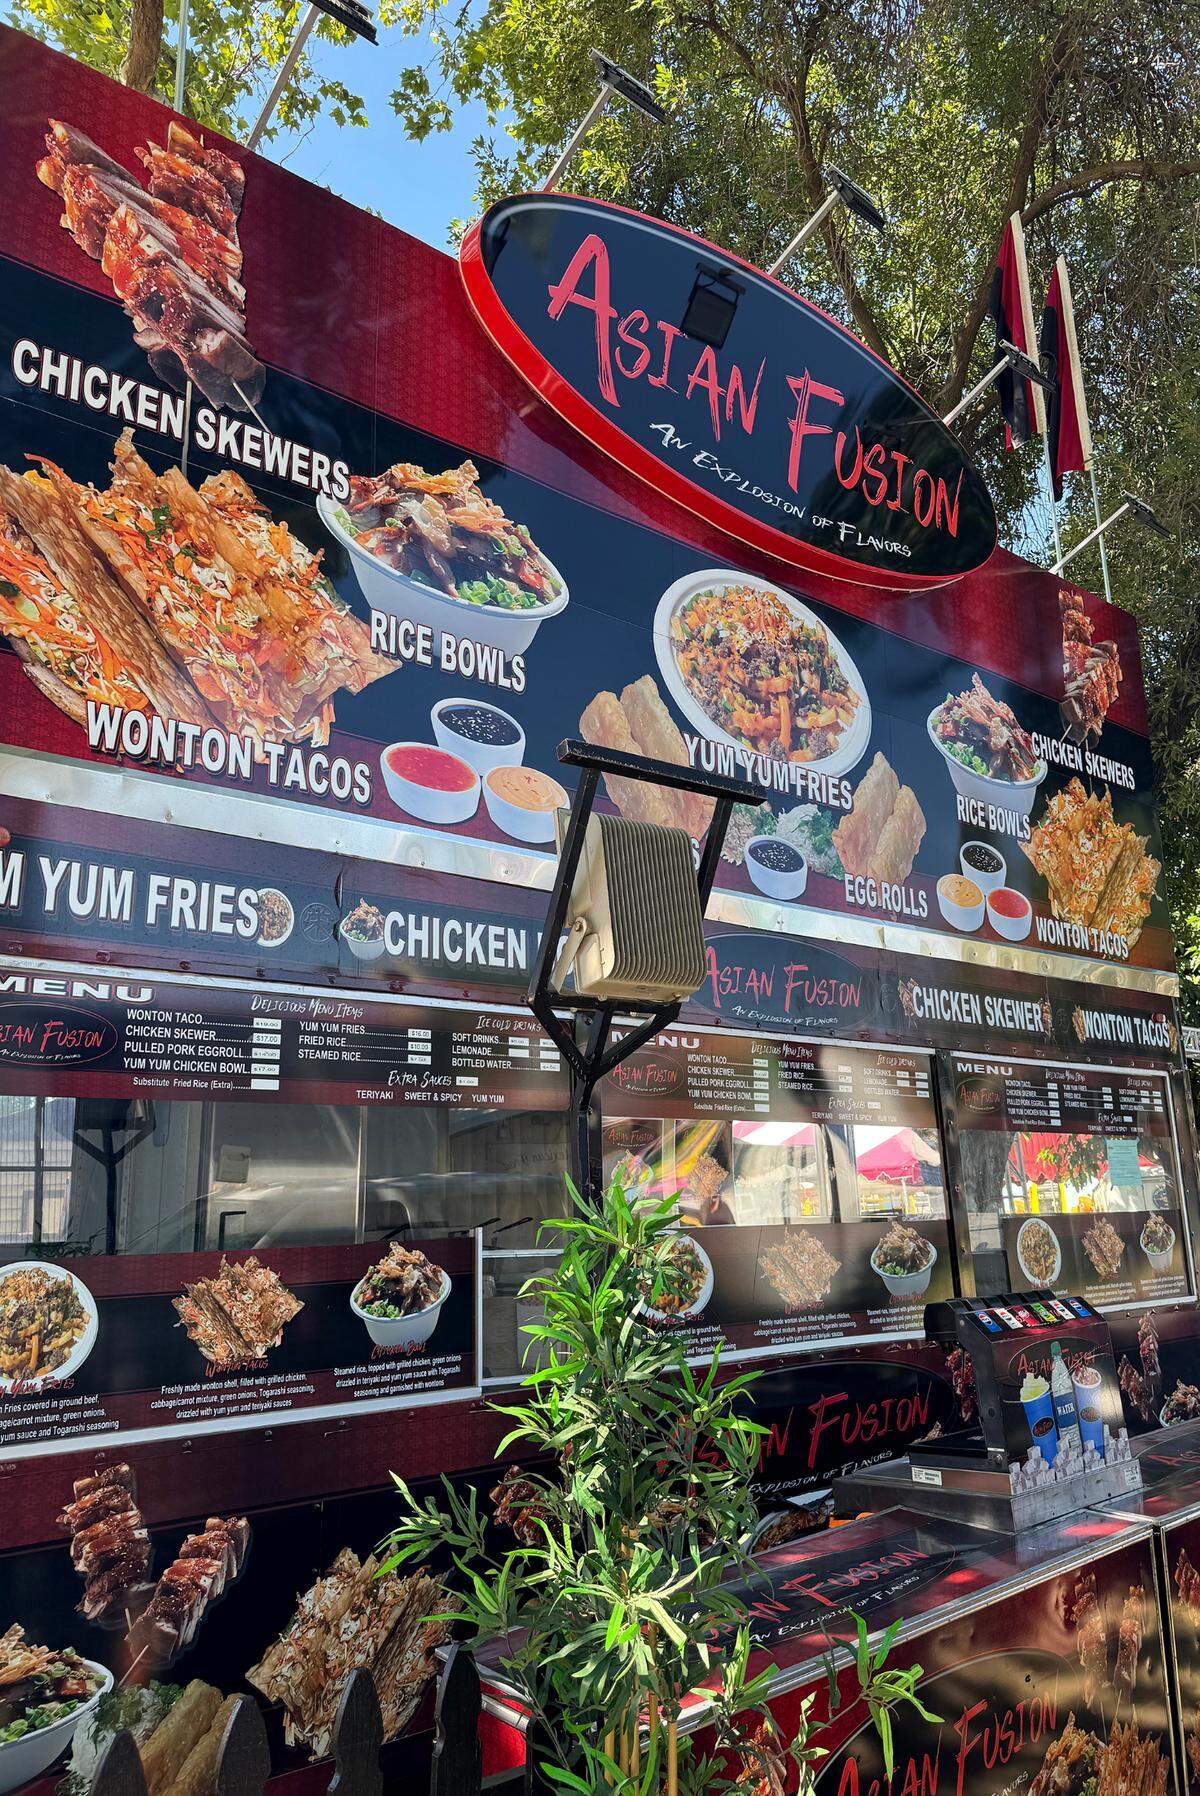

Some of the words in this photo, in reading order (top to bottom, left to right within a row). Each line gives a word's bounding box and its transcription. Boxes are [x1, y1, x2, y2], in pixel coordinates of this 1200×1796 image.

[548, 233, 766, 441] ASIAN
[786, 367, 964, 538] FUSION
[14, 339, 185, 439] CHICKEN
[195, 408, 350, 501] SKEWERS
[649, 422, 693, 449] AN
[693, 451, 805, 519] EXPLOSION
[812, 514, 832, 528] OF
[835, 521, 912, 557] FLAVORS
[371, 609, 433, 666] RICE
[441, 632, 527, 693] BOWLS
[87, 700, 253, 782] WONTON
[264, 741, 372, 804] TACOS
[1031, 732, 1082, 774] CHICKEN
[1083, 748, 1136, 791] SKEWERS
[683, 734, 735, 778] YUM
[741, 750, 791, 793] YUM
[795, 767, 853, 812] FRIES
[956, 794, 984, 826] RICE
[987, 802, 1031, 841] BOWLS
[39, 856, 135, 923] YUM
[146, 873, 259, 938] FRIES
[844, 875, 878, 908] EGG
[881, 882, 928, 917] ROLLS
[384, 911, 527, 969] CHICKEN
[1036, 916, 1088, 951] WONTON
[1090, 927, 1129, 959] TACOS
[0, 976, 153, 1002] MENU
[705, 945, 776, 1008] ASIAN
[783, 961, 863, 1013] FUSION
[127, 1009, 172, 1023] WONTON
[175, 1011, 202, 1024] TACO
[251, 995, 306, 1013] DELICIOUS
[308, 998, 334, 1018] MENU
[731, 1005, 746, 1016] AN
[747, 1010, 793, 1023] EXPLOSION
[912, 985, 982, 1025] CHICKEN
[985, 995, 1043, 1032] SKEWER
[126, 1025, 171, 1039] CHICKEN
[173, 1028, 216, 1041] SKEWER
[256, 1035, 278, 1043] $17.00
[300, 1021, 319, 1031] YUM
[321, 1022, 339, 1032] YUM
[341, 1024, 365, 1034] FRIES
[475, 1015, 491, 1029] ICE
[492, 1017, 511, 1031] COLD
[513, 1018, 542, 1032] DRINKS
[1082, 1009, 1133, 1042] WONTON
[1134, 1016, 1170, 1048] TACOS
[40, 1020, 106, 1052] FUSION
[299, 1035, 322, 1045] FRIED
[324, 1037, 346, 1047] RICE
[452, 1033, 472, 1043] SOFT
[473, 1034, 500, 1044] DRINKS
[124, 1041, 165, 1054] PULLED
[167, 1043, 195, 1056] PORK
[197, 1045, 244, 1058] EGGROLL
[298, 1050, 339, 1061] STEAMED
[341, 1051, 361, 1062] RICE
[452, 1045, 492, 1056] LEMONADE
[687, 1053, 710, 1064] WONTON
[123, 1057, 147, 1070] YUM
[149, 1059, 171, 1072] YUM
[173, 1060, 217, 1073] CHICKEN
[220, 1062, 249, 1075] BOWL
[452, 1058, 486, 1068] BOTTLED
[487, 1060, 511, 1069] WATER
[687, 1065, 712, 1075] CHICKEN
[957, 1062, 1013, 1075] MENU
[133, 1075, 169, 1088] Substitute
[173, 1078, 192, 1088] Fried
[194, 1079, 209, 1089] Rice
[210, 1079, 234, 1091] (Extra)
[388, 1070, 417, 1087] EXTRA
[420, 1071, 452, 1088] SAUCES
[688, 1078, 709, 1087] PULLED
[710, 1079, 724, 1088] PORK
[778, 1082, 801, 1090] STEAMED
[356, 1090, 393, 1100] TERIYAKI
[405, 1091, 432, 1101] SWEET
[433, 1092, 440, 1101] &
[441, 1093, 462, 1103] SPICY
[472, 1094, 487, 1103] YUM
[489, 1095, 505, 1103] YUM
[687, 1089, 701, 1098] YUM
[701, 1090, 713, 1099] YUM
[713, 1091, 737, 1100] CHICKEN
[334, 1366, 355, 1376] Steamed
[368, 1362, 385, 1373] topped
[386, 1361, 397, 1370] with
[397, 1359, 411, 1371] grilled
[446, 1354, 462, 1363] onions
[161, 1384, 184, 1396] Freshly
[185, 1382, 200, 1391] made
[201, 1381, 223, 1391] wonton
[240, 1377, 254, 1387] filled
[255, 1376, 267, 1385] with
[267, 1374, 284, 1386] grilled
[285, 1372, 307, 1382] chicken,
[336, 1377, 356, 1388] drizzled
[362, 1374, 380, 1386] teriyaki
[413, 1370, 427, 1378] sauce
[428, 1368, 438, 1376] with
[439, 1365, 460, 1377] Togarashi
[151, 1396, 195, 1409] cabbage/carrot
[196, 1394, 219, 1404] mixture,
[220, 1393, 237, 1404] green
[259, 1386, 286, 1399] Togarashi
[354, 1387, 379, 1398] seasoning
[380, 1385, 389, 1394] and
[390, 1382, 413, 1394] garnished
[414, 1381, 424, 1390] with
[425, 1379, 445, 1389] wontons
[4, 1403, 21, 1413] Fries
[23, 1400, 50, 1411] covered
[51, 1399, 58, 1408] in
[59, 1396, 83, 1409] ground
[84, 1394, 100, 1405] beef,
[176, 1408, 199, 1419] drizzled
[200, 1407, 213, 1416] with
[213, 1405, 226, 1416] yum
[227, 1404, 240, 1415] yum
[240, 1402, 251, 1411] and
[251, 1400, 272, 1412] teriyaki
[273, 1399, 292, 1408] sauces
[1057, 1403, 1075, 1416] WATER
[34, 1413, 61, 1424] mixture,
[63, 1411, 82, 1422] green
[83, 1408, 107, 1419] onions,
[808, 1380, 932, 1469] FUSION
[0, 1434, 15, 1444] yum
[17, 1430, 37, 1440] sauce
[38, 1428, 51, 1438] and
[53, 1422, 86, 1436] Togarashi
[87, 1420, 119, 1431] seasoning
[749, 1471, 819, 1495] EXPLOSION
[823, 1468, 838, 1480] OF
[840, 1450, 893, 1477] FLAVORS
[780, 1544, 929, 1606] FUSION
[778, 1606, 853, 1635] EXPLOSION
[953, 1668, 1059, 1796] FUSION
